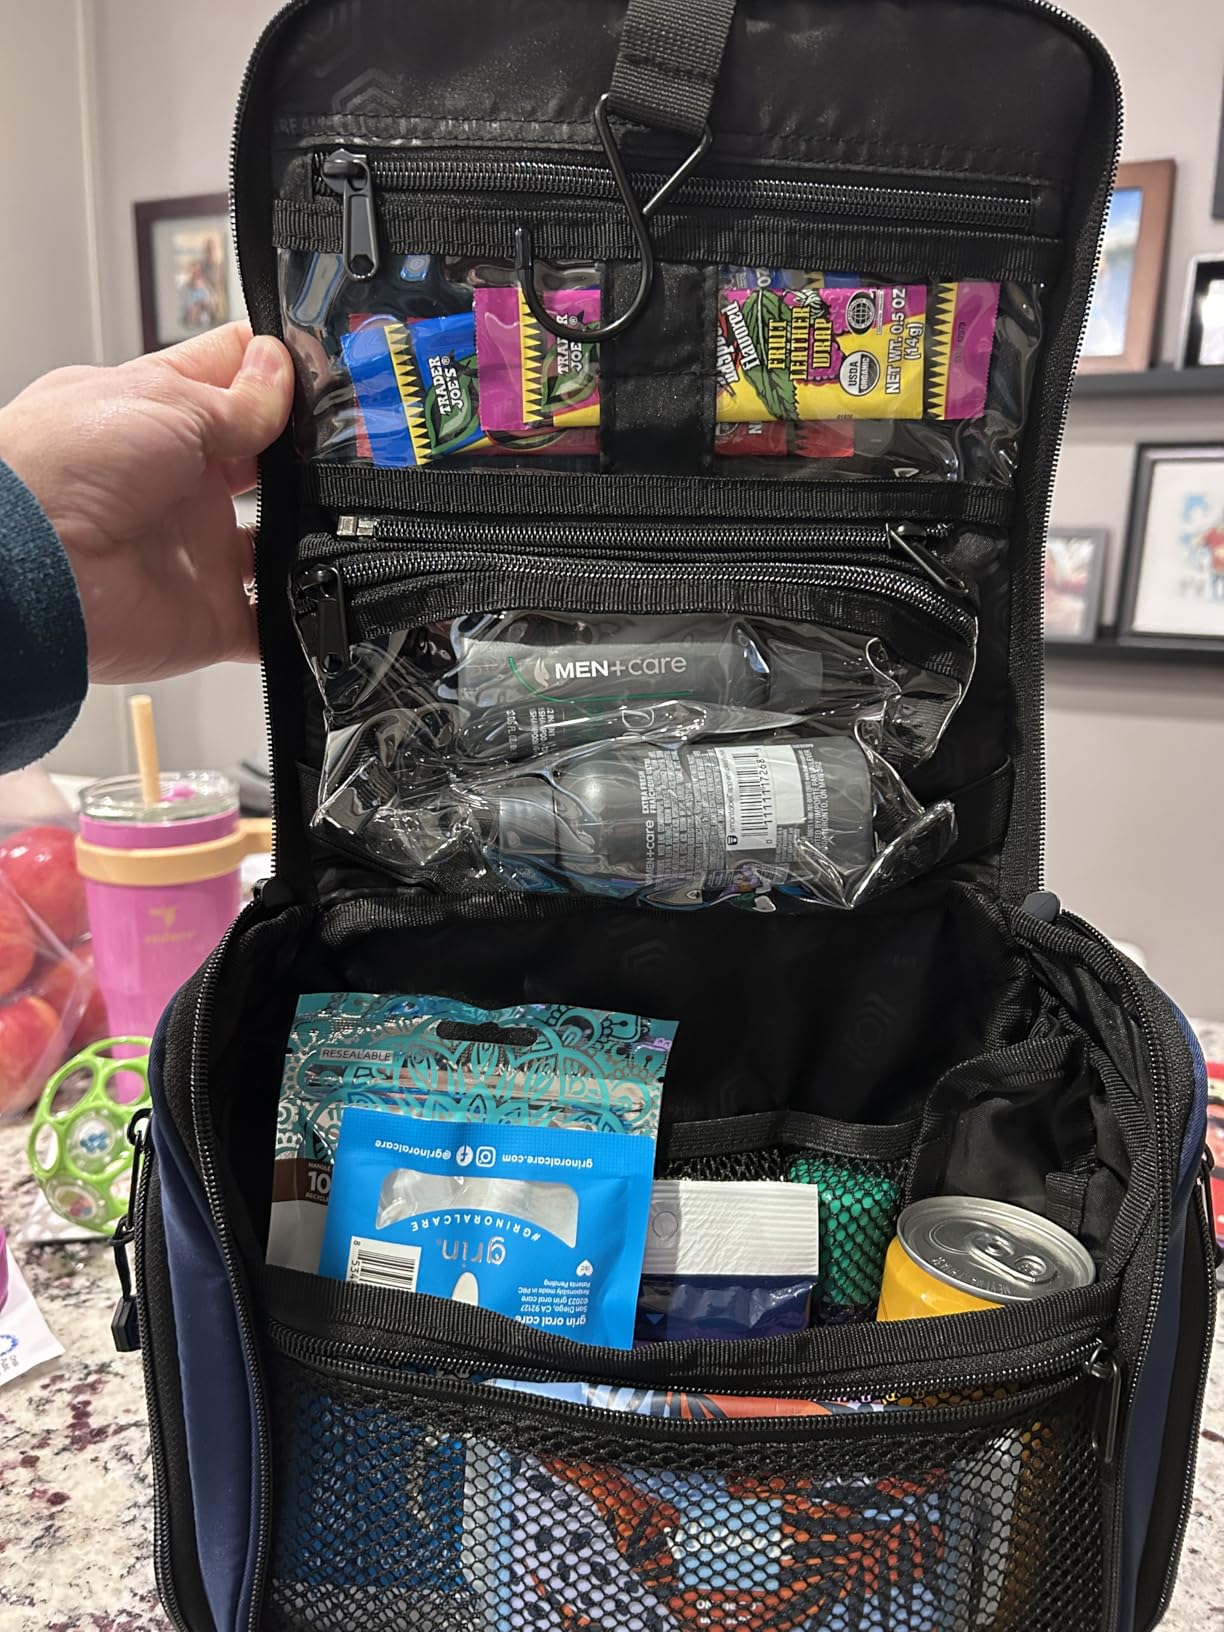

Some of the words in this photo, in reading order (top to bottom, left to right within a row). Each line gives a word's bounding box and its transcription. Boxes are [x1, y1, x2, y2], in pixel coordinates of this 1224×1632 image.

[892, 288, 906, 310] OZ
[891, 312, 905, 334] 0.5
[556, 313, 569, 375] TRAR
[767, 319, 787, 370] FRUIT
[789, 306, 811, 381] LEATHER
[812, 318, 833, 369] WRAP
[888, 336, 903, 364] WT.
[848, 361, 859, 387] USDA
[860, 357, 871, 390] ORGANIC
[885, 365, 900, 395] NET
[428, 356, 452, 416] TRADER
[444, 367, 464, 412] JOE'S
[555, 656, 687, 679] MEN+care
[322, 1049, 392, 1062] RESEALABLE
[375, 1139, 451, 1160] @grinoralcare
[502, 1153, 593, 1169] grinoralcare.com
[410, 1213, 542, 1242] #GRINORALCARE
[442, 1236, 506, 1268] grin
[520, 1304, 541, 1312] 92127
[541, 1305, 552, 1313] CA
[552, 1304, 575, 1313] Diego,
[553, 1296, 567, 1305] grin
[575, 1305, 588, 1313] San
[515, 1315, 540, 1325] care
[541, 1316, 564, 1328] oral
[565, 1314, 586, 1328] grin
